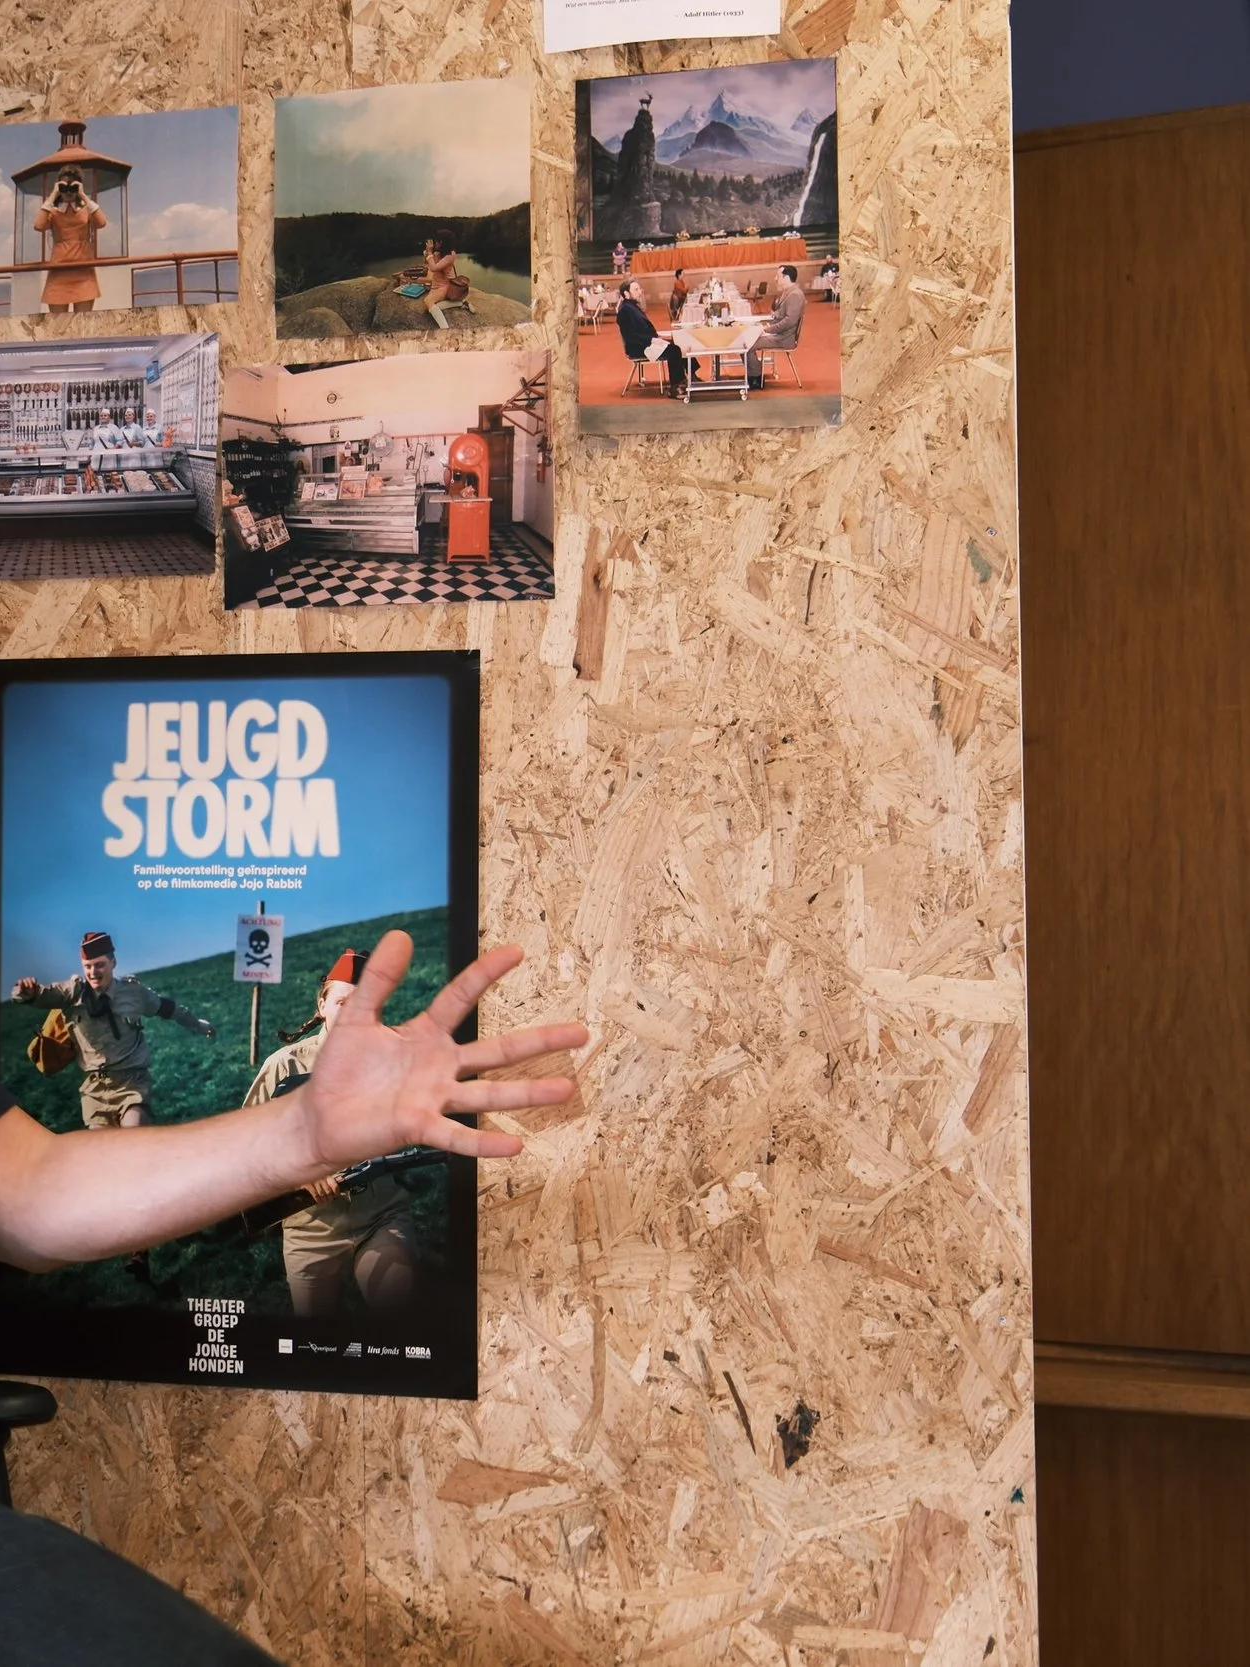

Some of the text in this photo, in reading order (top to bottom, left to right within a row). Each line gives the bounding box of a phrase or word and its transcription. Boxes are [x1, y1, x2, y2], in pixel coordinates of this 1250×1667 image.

[684, 10, 701, 18] Adolf
[113, 699, 328, 779] JEUGD
[102, 778, 340, 859] STORM
[133, 864, 307, 878] Familievoorstelling geïnspireerd
[137, 878, 302, 891] op de filmkomedie Jojo Rabbit
[187, 1298, 245, 1314] THEATER
[194, 1313, 239, 1328] GROEP
[208, 1328, 225, 1343] DE
[195, 1343, 237, 1358] JONGE
[367, 1345, 380, 1354] lira
[380, 1346, 400, 1356] fonds
[405, 1346, 431, 1356] KOBRA
[189, 1357, 244, 1374] HONDEN
